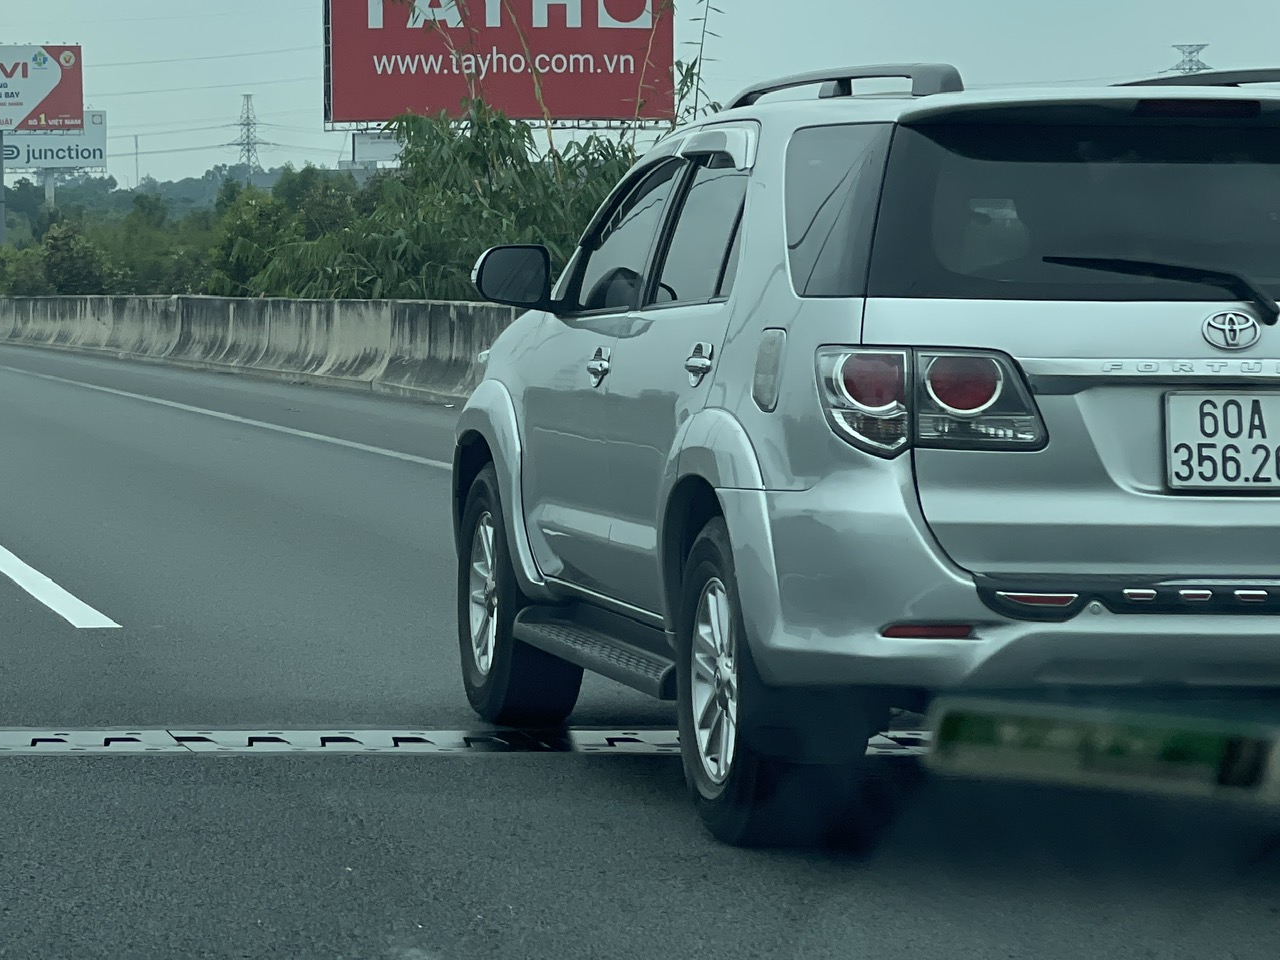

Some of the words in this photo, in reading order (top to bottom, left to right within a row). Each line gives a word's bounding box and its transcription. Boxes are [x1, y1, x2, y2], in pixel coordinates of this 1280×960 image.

[373, 46, 635, 81] www.tayho.com.vn
[4, 91, 20, 99] BAY
[39, 113, 47, 125] 1
[25, 144, 103, 164] junction
[1102, 361, 1280, 373] FORTU
[1199, 399, 1267, 439] 60A
[1174, 443, 1280, 482] 356.2
